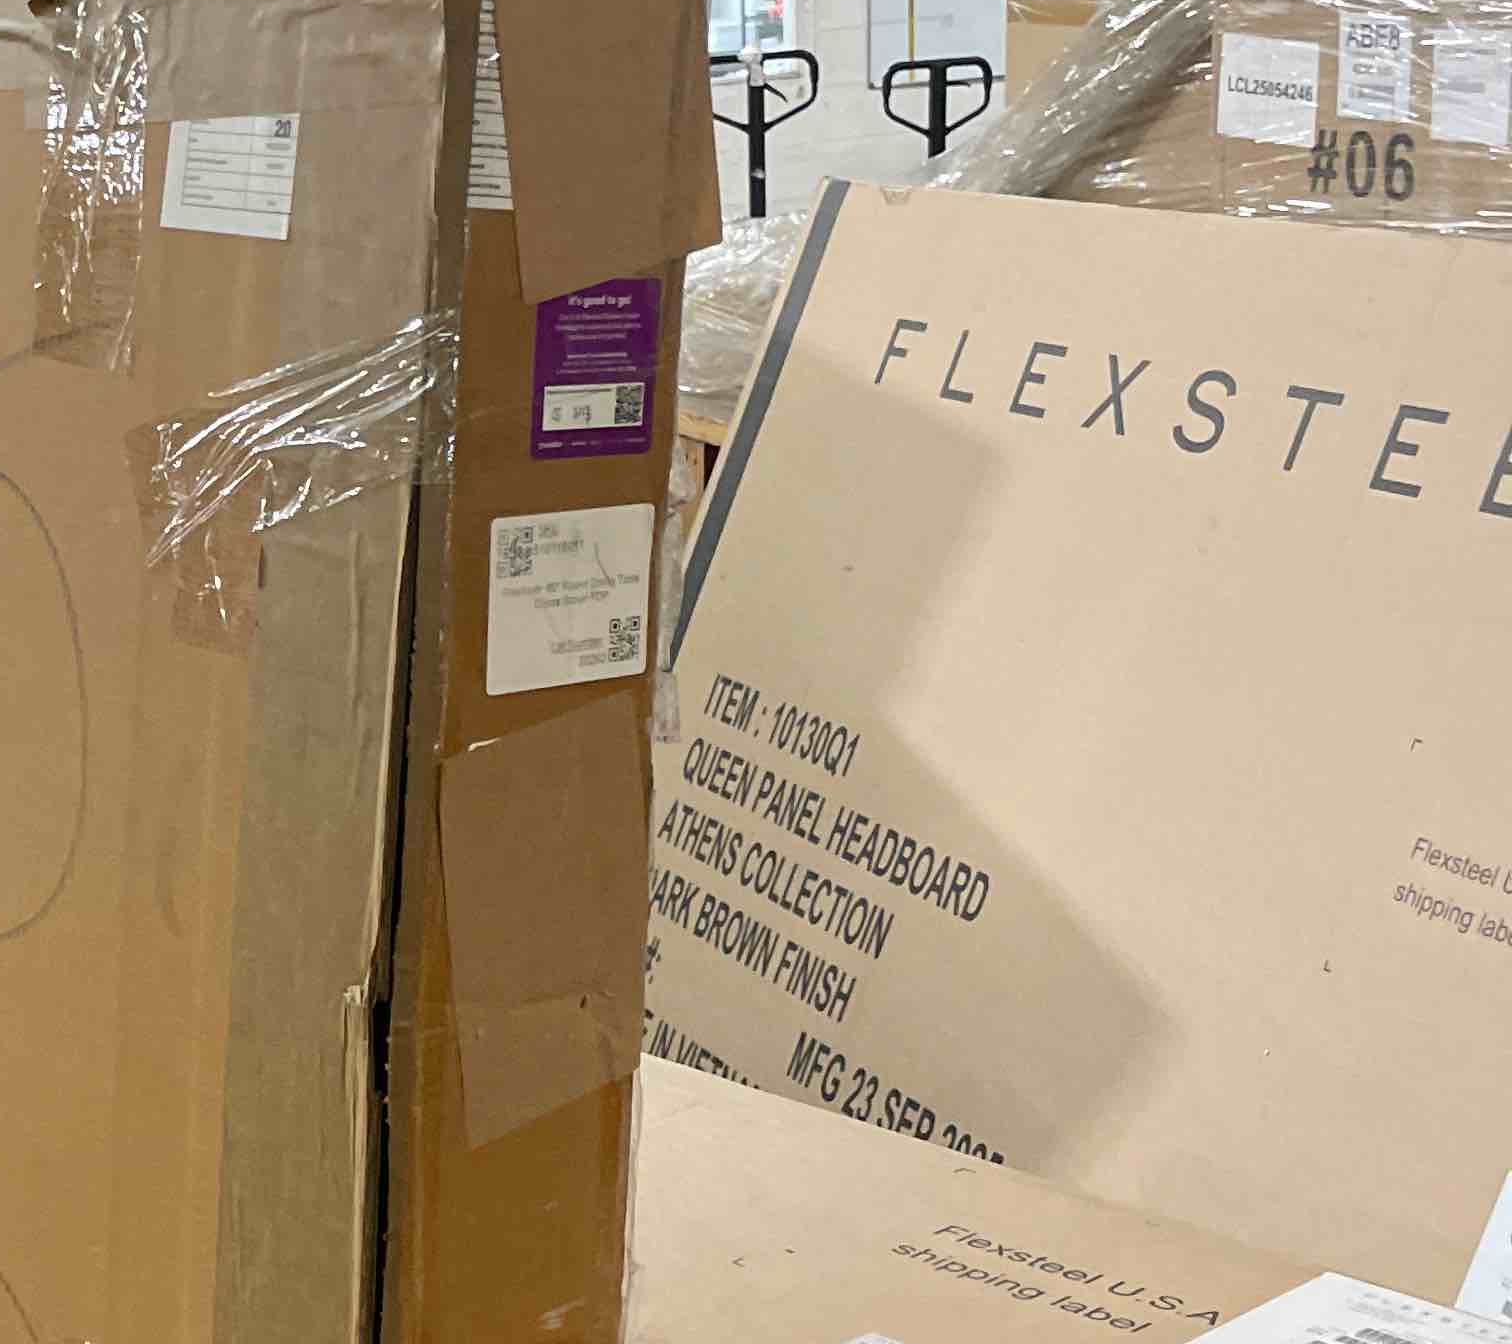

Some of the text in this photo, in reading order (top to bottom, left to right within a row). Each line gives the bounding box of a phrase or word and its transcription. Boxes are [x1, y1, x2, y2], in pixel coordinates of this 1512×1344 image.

[1307, 129, 1415, 201] #06
[703, 673, 760, 732] ITEM
[768, 702, 860, 777] 10130Q1
[683, 737, 989, 922] QUEEN PANEL HEADBOARD
[1409, 837, 1501, 888] Flexsteel
[657, 800, 894, 959] ATHENS COLLECTIOIN
[1392, 883, 1475, 934] shipping
[648, 863, 857, 1023] ARK BROWN FINISH
[786, 1031, 846, 1102] MFG
[841, 1067, 879, 1123] 23
[891, 1242, 1153, 1334] shipping label
[933, 1224, 1221, 1327] Flexsteel U.S.A
